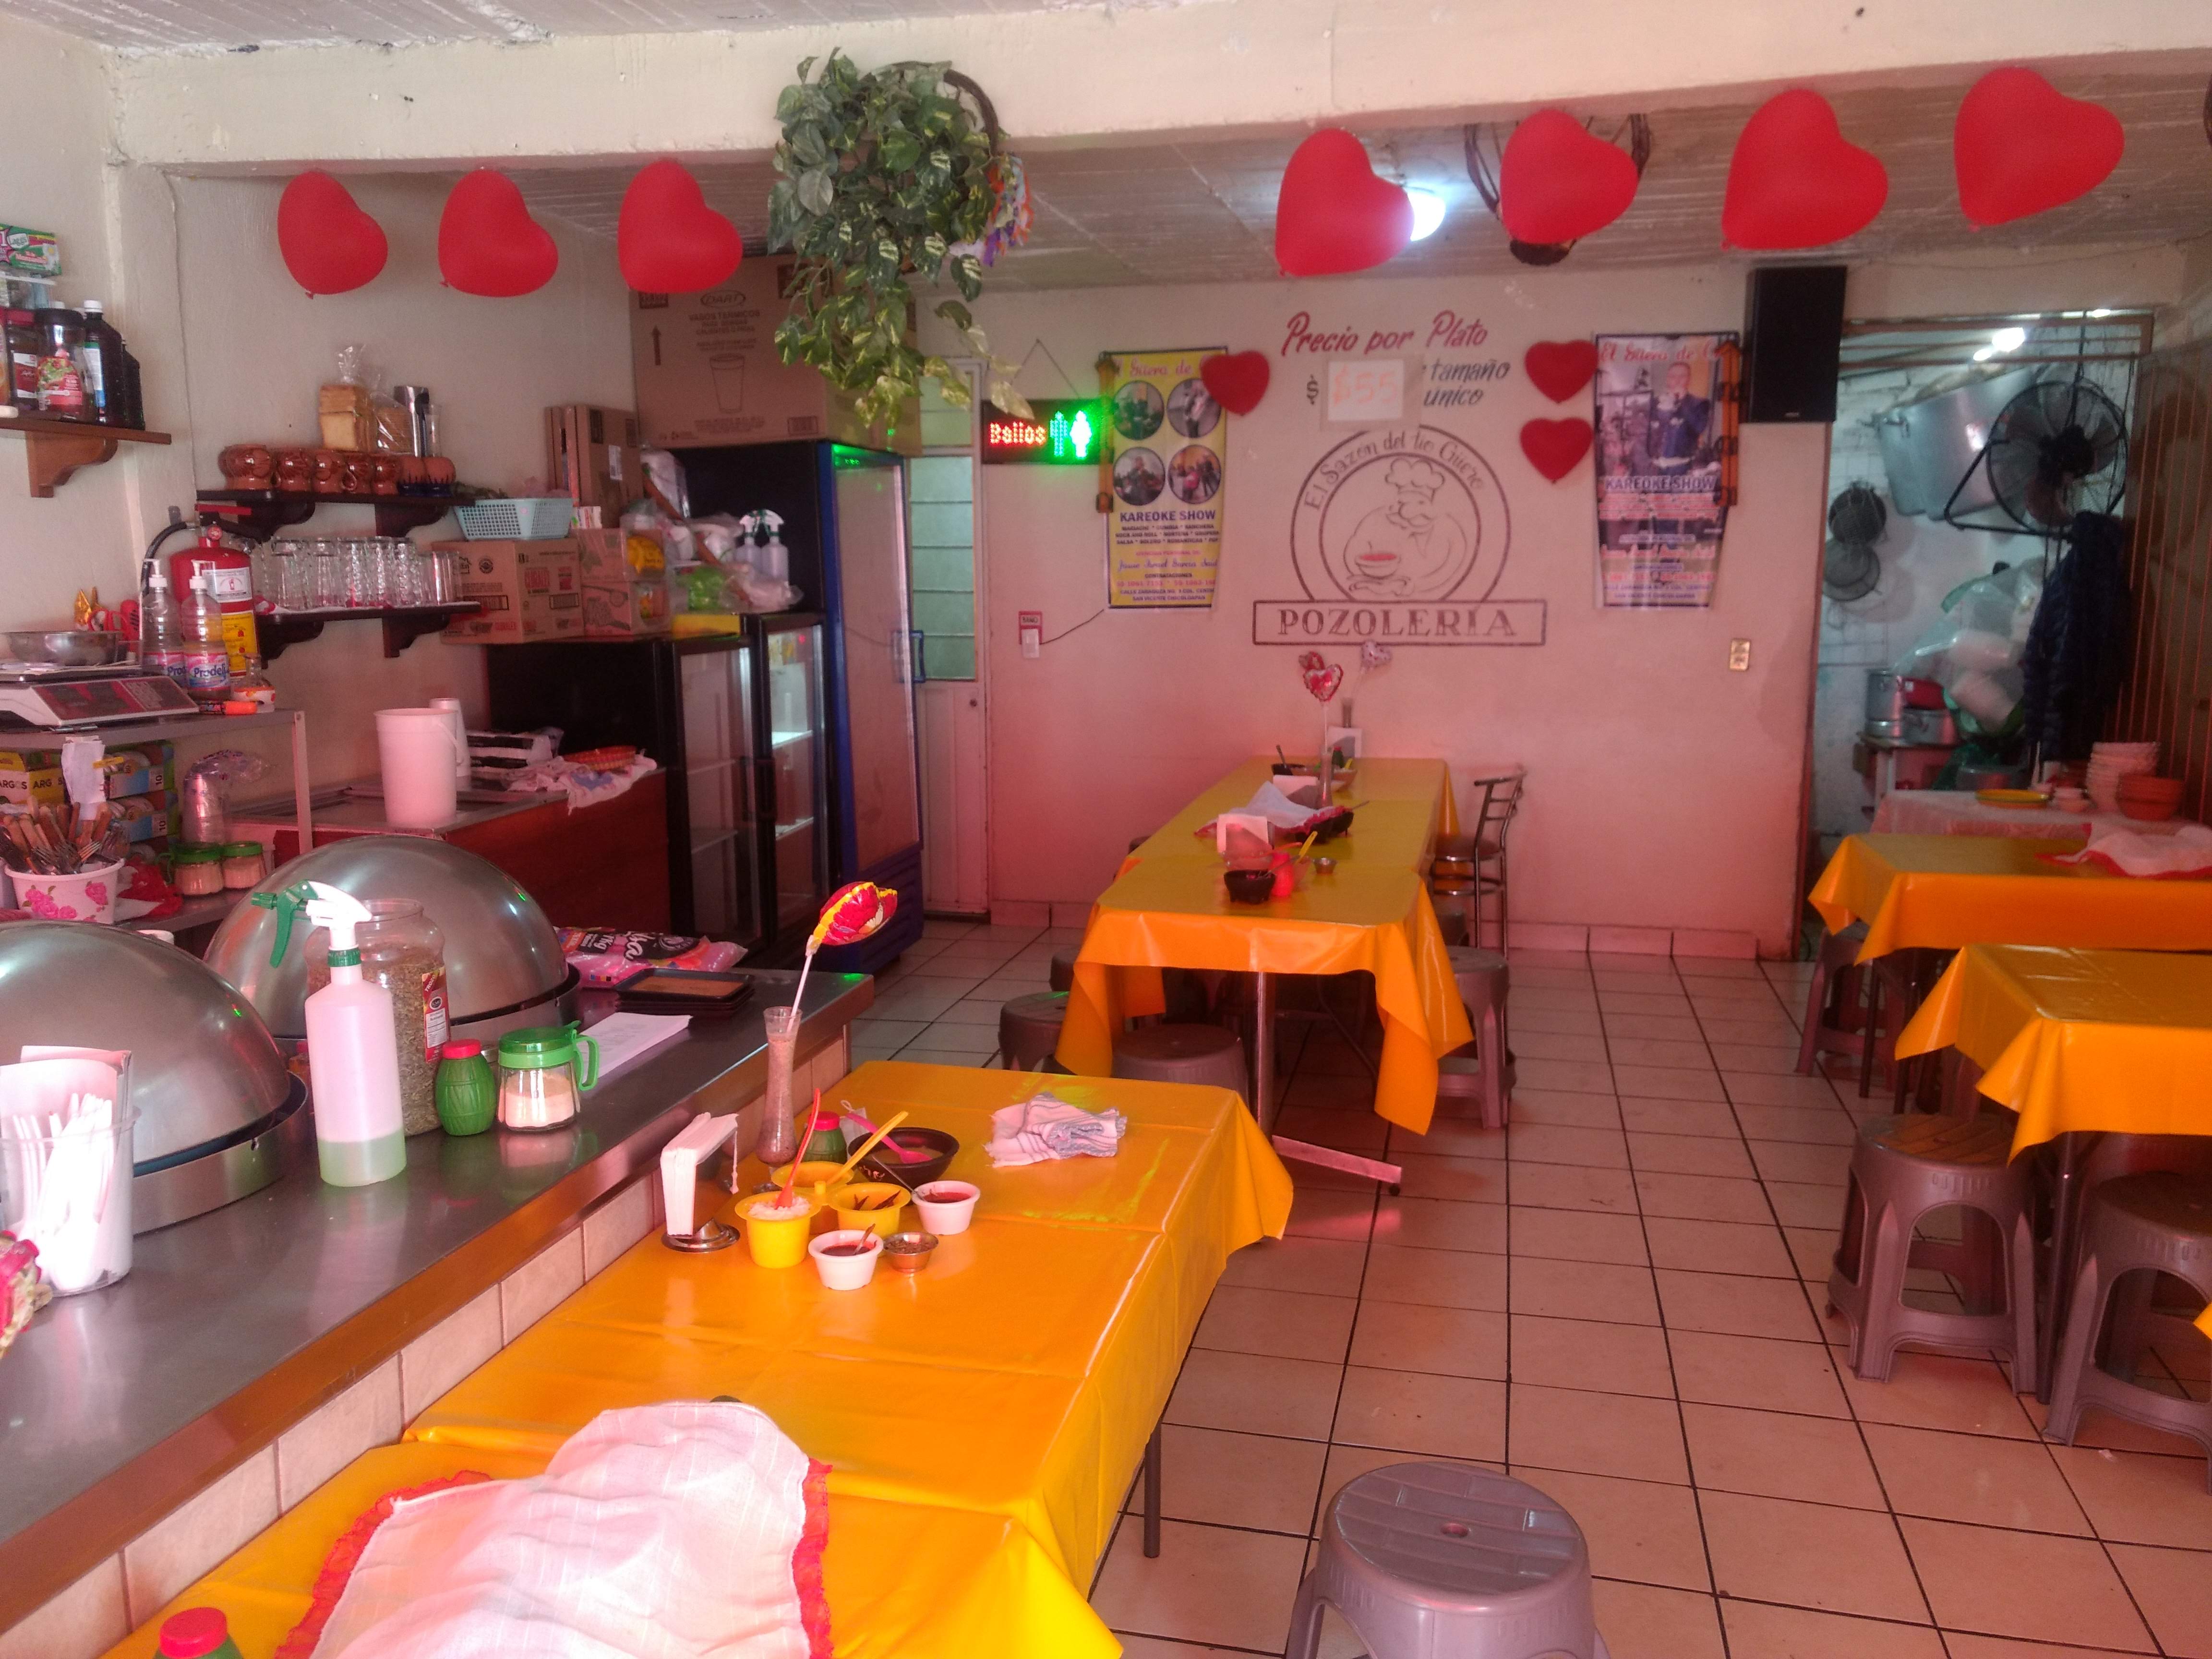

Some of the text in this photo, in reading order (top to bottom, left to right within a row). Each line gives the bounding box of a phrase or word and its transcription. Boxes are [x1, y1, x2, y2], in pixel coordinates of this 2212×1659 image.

[1282, 310, 1488, 356] Precio por Plato
[1430, 358, 1511, 384] tamaño
[1304, 483, 1328, 510] El
[1383, 430, 1405, 450] del
[1120, 510, 1216, 522] KAREOKE SHOW
